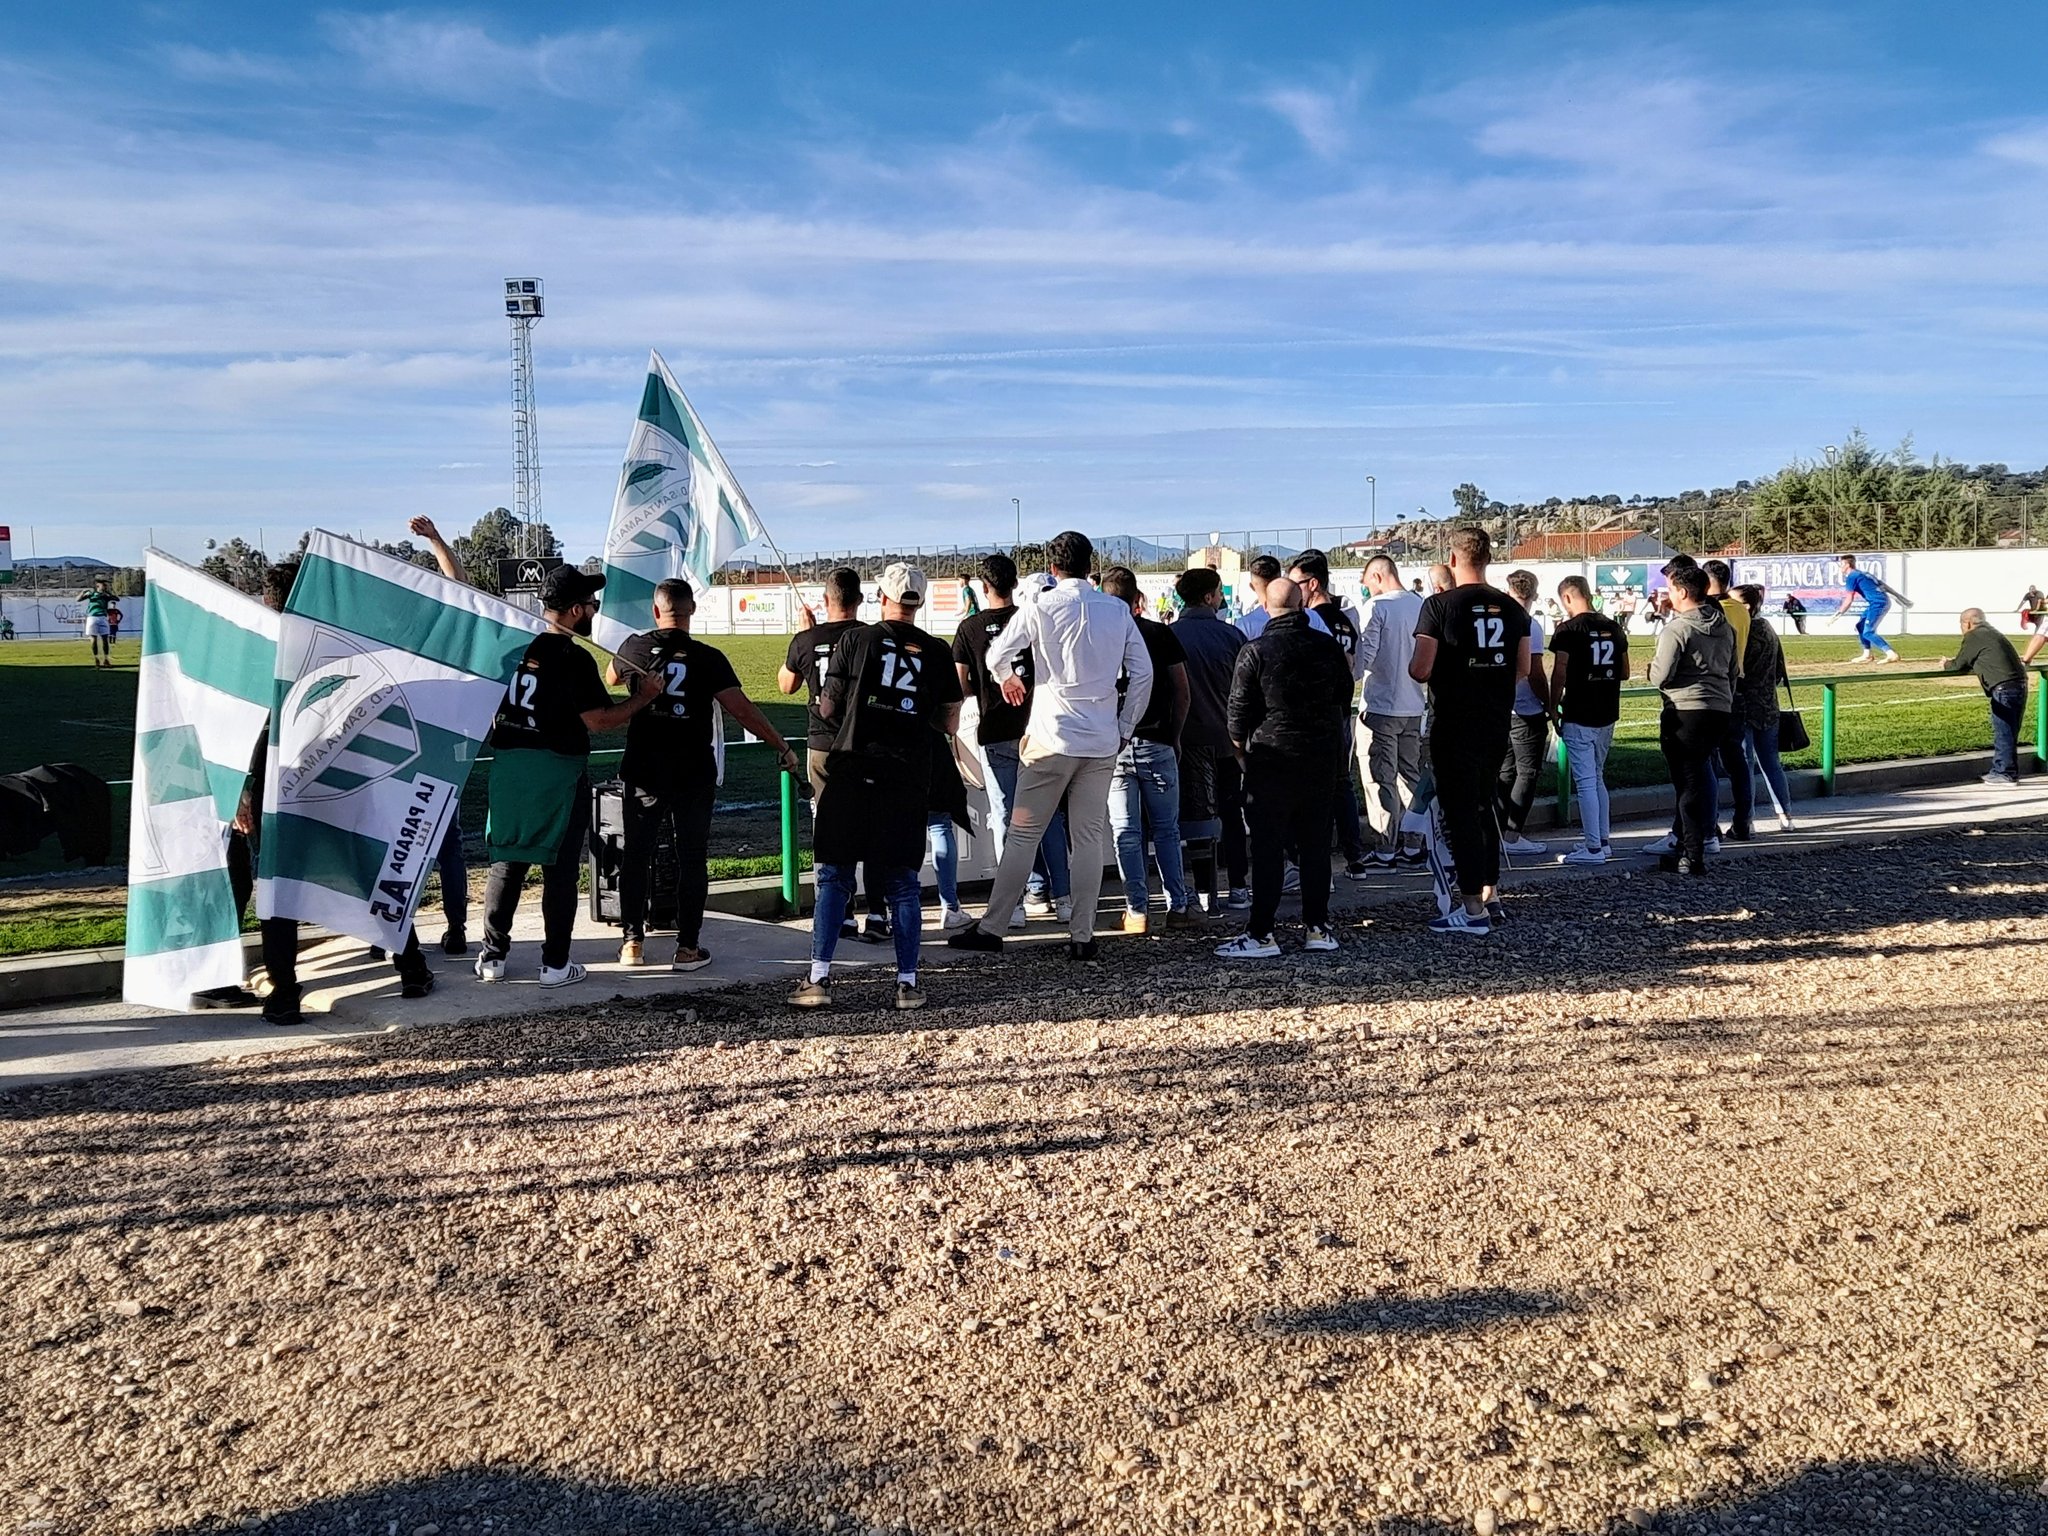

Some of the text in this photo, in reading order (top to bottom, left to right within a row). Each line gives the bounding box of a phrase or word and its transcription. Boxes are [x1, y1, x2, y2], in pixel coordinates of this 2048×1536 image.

[1771, 560, 1882, 587] BANCA PUYO
[1473, 618, 1504, 648] 12
[1590, 641, 1614, 665] 12
[660, 662, 687, 696] 2
[815, 656, 829, 687] 1
[881, 652, 921, 692] 12
[509, 671, 537, 710] 12
